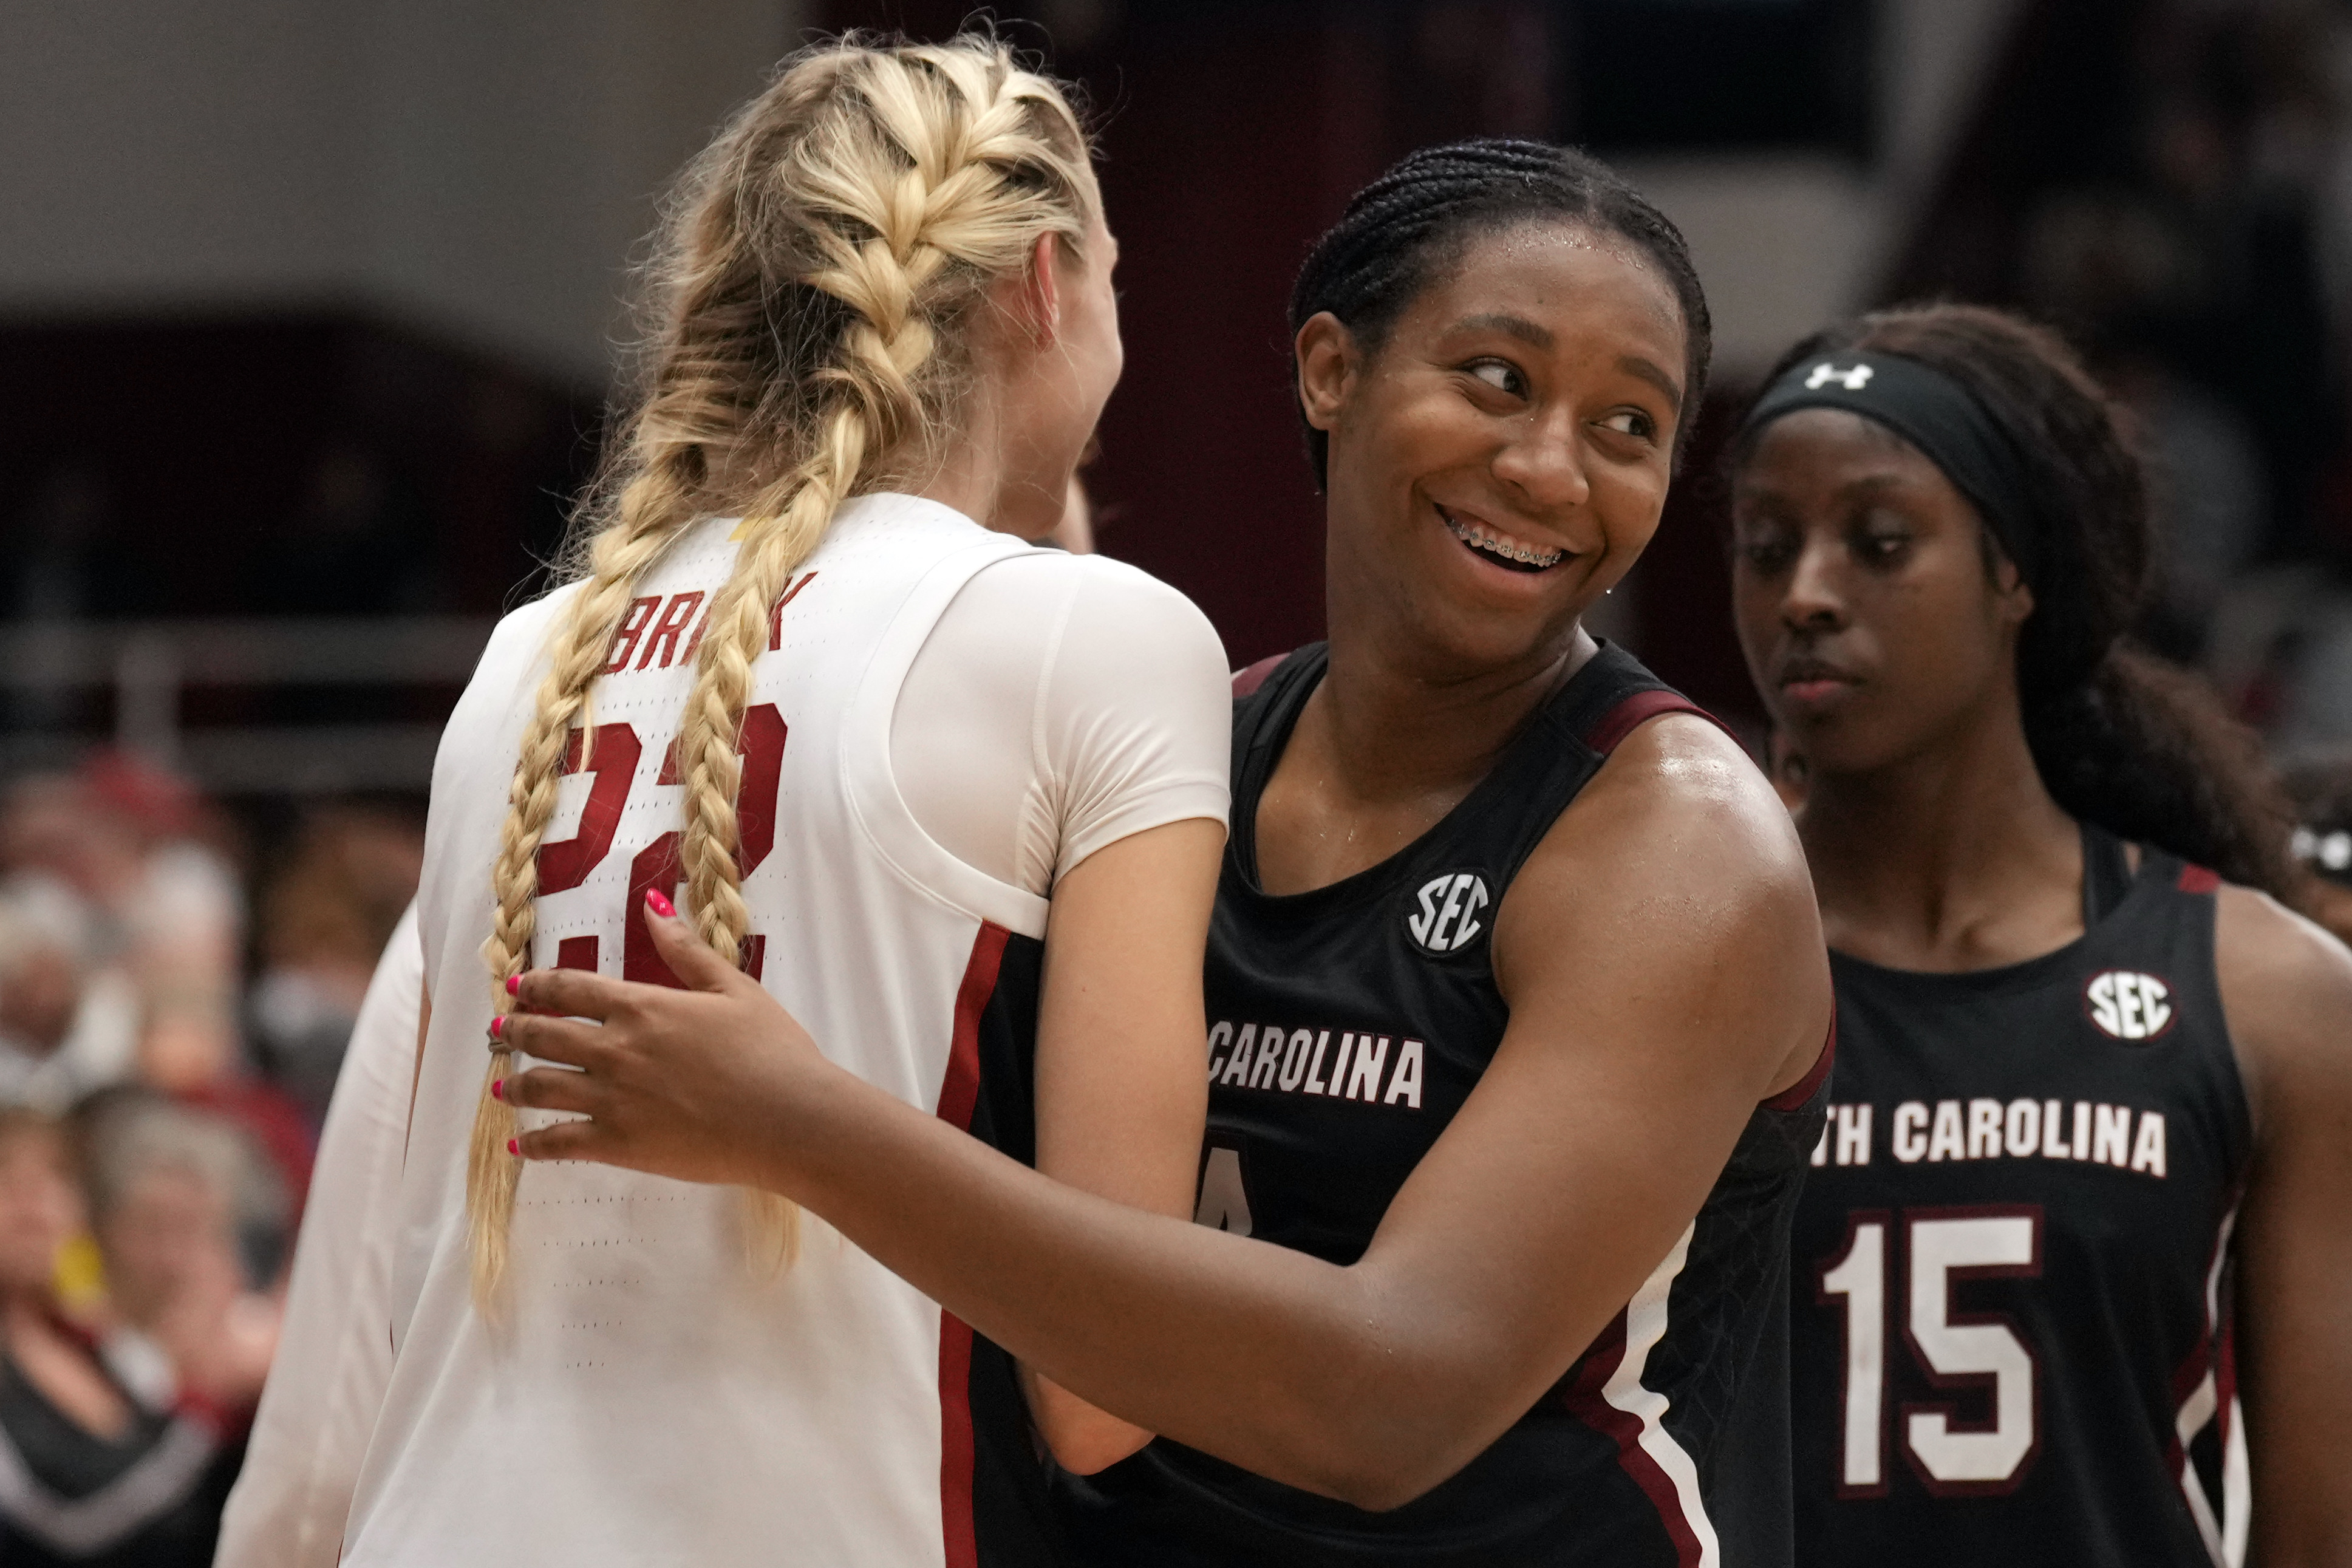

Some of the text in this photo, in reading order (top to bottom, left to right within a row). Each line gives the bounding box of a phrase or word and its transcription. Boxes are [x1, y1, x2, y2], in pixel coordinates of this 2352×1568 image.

[1408, 873, 1488, 951] SEC
[2087, 971, 2172, 1040] SEC
[1207, 1020, 1423, 1109] CAROLINA
[1892, 1097, 2168, 1178] CAROLINA
[1819, 1211, 2039, 1492] 15
